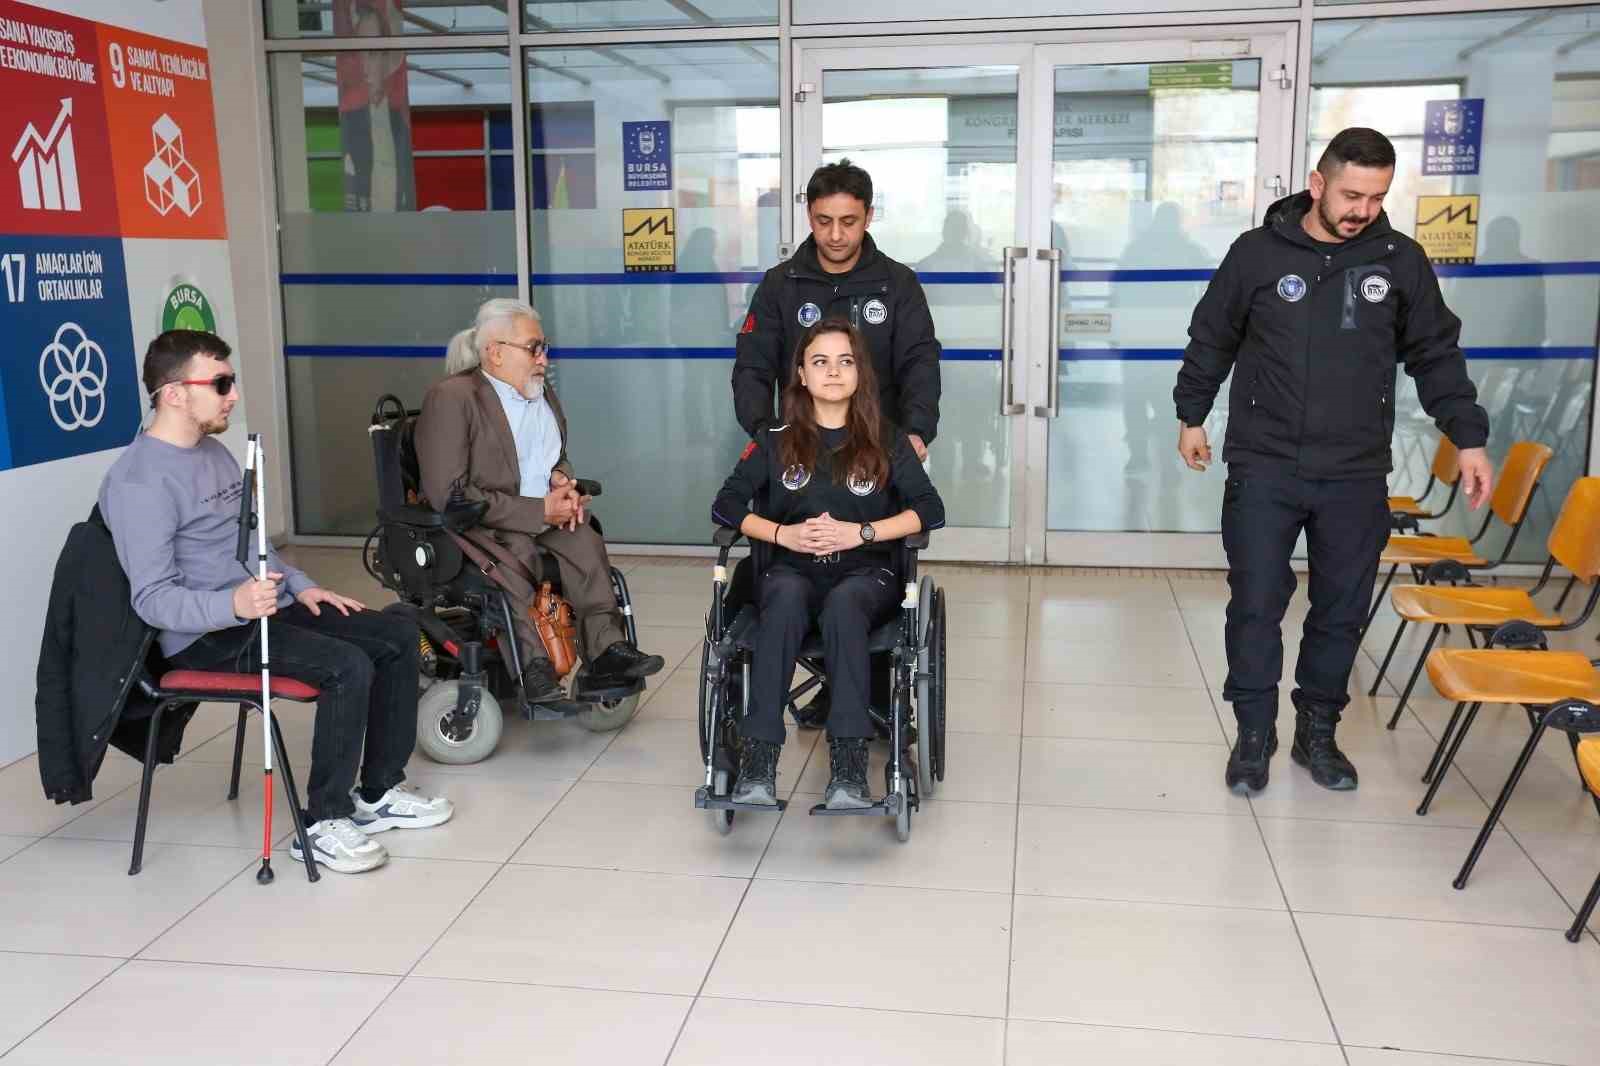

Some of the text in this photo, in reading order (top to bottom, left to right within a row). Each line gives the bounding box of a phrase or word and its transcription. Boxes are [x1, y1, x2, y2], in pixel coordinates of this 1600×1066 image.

[26, 23, 65, 53] YAKIŞIR
[63, 29, 75, 57] İŞ
[7, 45, 59, 77] EKONOMİK
[57, 55, 96, 84] BÜYÜME
[109, 42, 126, 89] 9
[159, 52, 208, 81] YENİLİKÇİLİK
[130, 71, 176, 98] VE ALTYAPI
[1427, 144, 1475, 156] BURSA
[627, 162, 667, 173] BURSA
[627, 240, 672, 250] ATATÜRK
[36, 250, 103, 276] AMAÇLAR İÇİN
[1, 253, 25, 303] 17
[38, 279, 104, 301] ORTAKLIKLAR
[170, 287, 202, 311] BURSA
